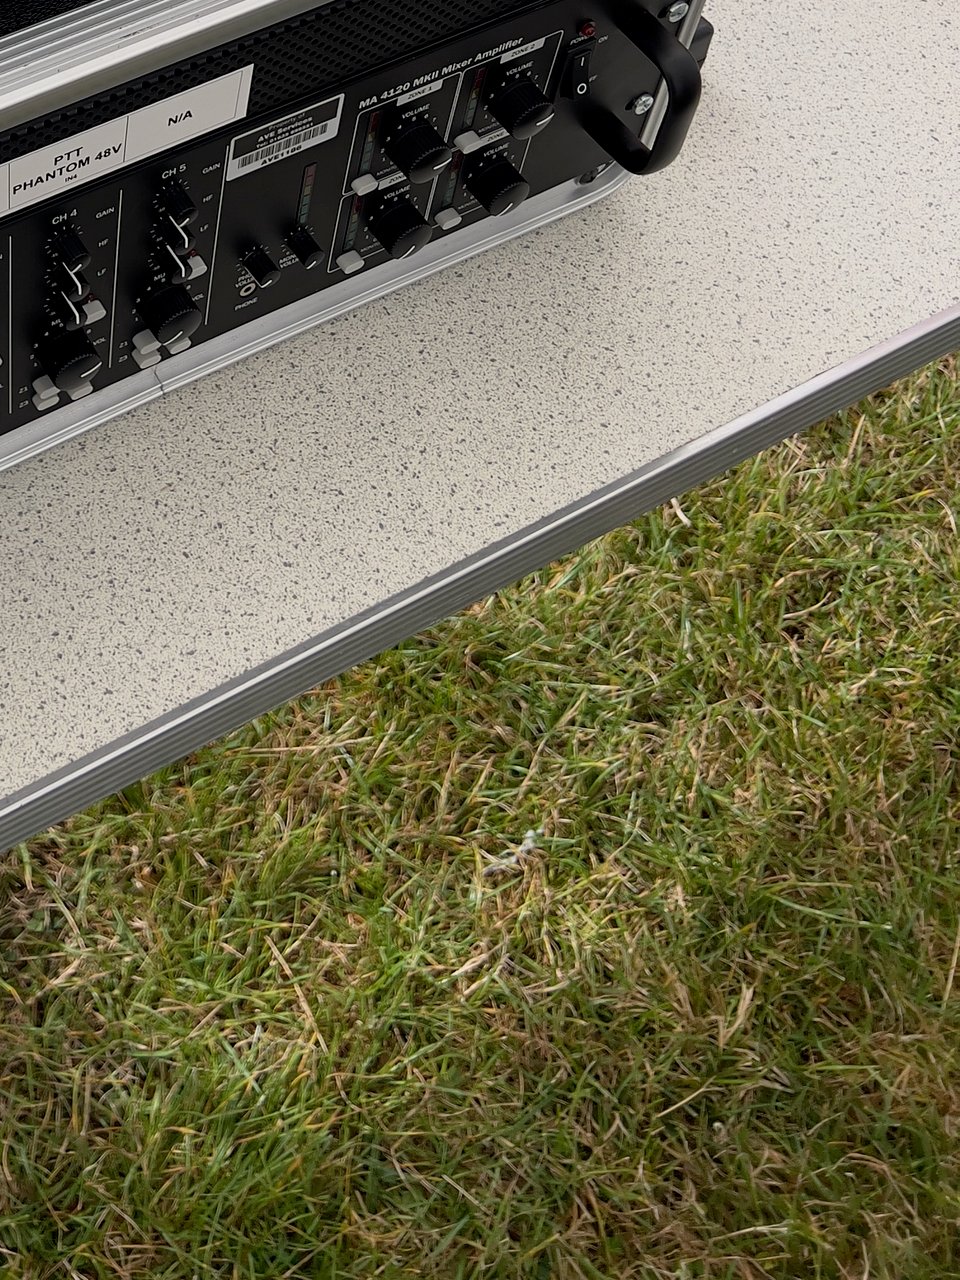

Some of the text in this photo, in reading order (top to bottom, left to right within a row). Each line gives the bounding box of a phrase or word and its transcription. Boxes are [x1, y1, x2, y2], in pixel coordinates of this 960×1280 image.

[598, 35, 609, 44] ON
[511, 48, 528, 58] ZONE
[358, 37, 524, 109] MA 4120 MKII Mixer Amplifier
[506, 61, 534, 76] VOLUME
[407, 88, 424, 99] ZONE
[167, 109, 194, 127] N/A
[402, 104, 430, 120] VOLUME
[258, 131, 275, 142] AVE
[277, 117, 313, 134] Services
[54, 146, 84, 166] PTT
[483, 142, 510, 158] VOLUME
[12, 143, 123, 195] PHANTOM 48V
[161, 163, 187, 179] CH 5
[202, 162, 222, 174] GAIN
[64, 174, 78, 183] IN4
[203, 193, 214, 203] HF
[384, 185, 411, 200] VOLUME
[51, 209, 78, 225] CH 4
[95, 206, 115, 219] GAIN
[199, 223, 209, 233] LF
[98, 238, 109, 247] HF
[97, 267, 107, 277] LF
[234, 296, 259, 312] PHONE
[18, 386, 28, 394] Z1
[19, 399, 29, 408] Z3
